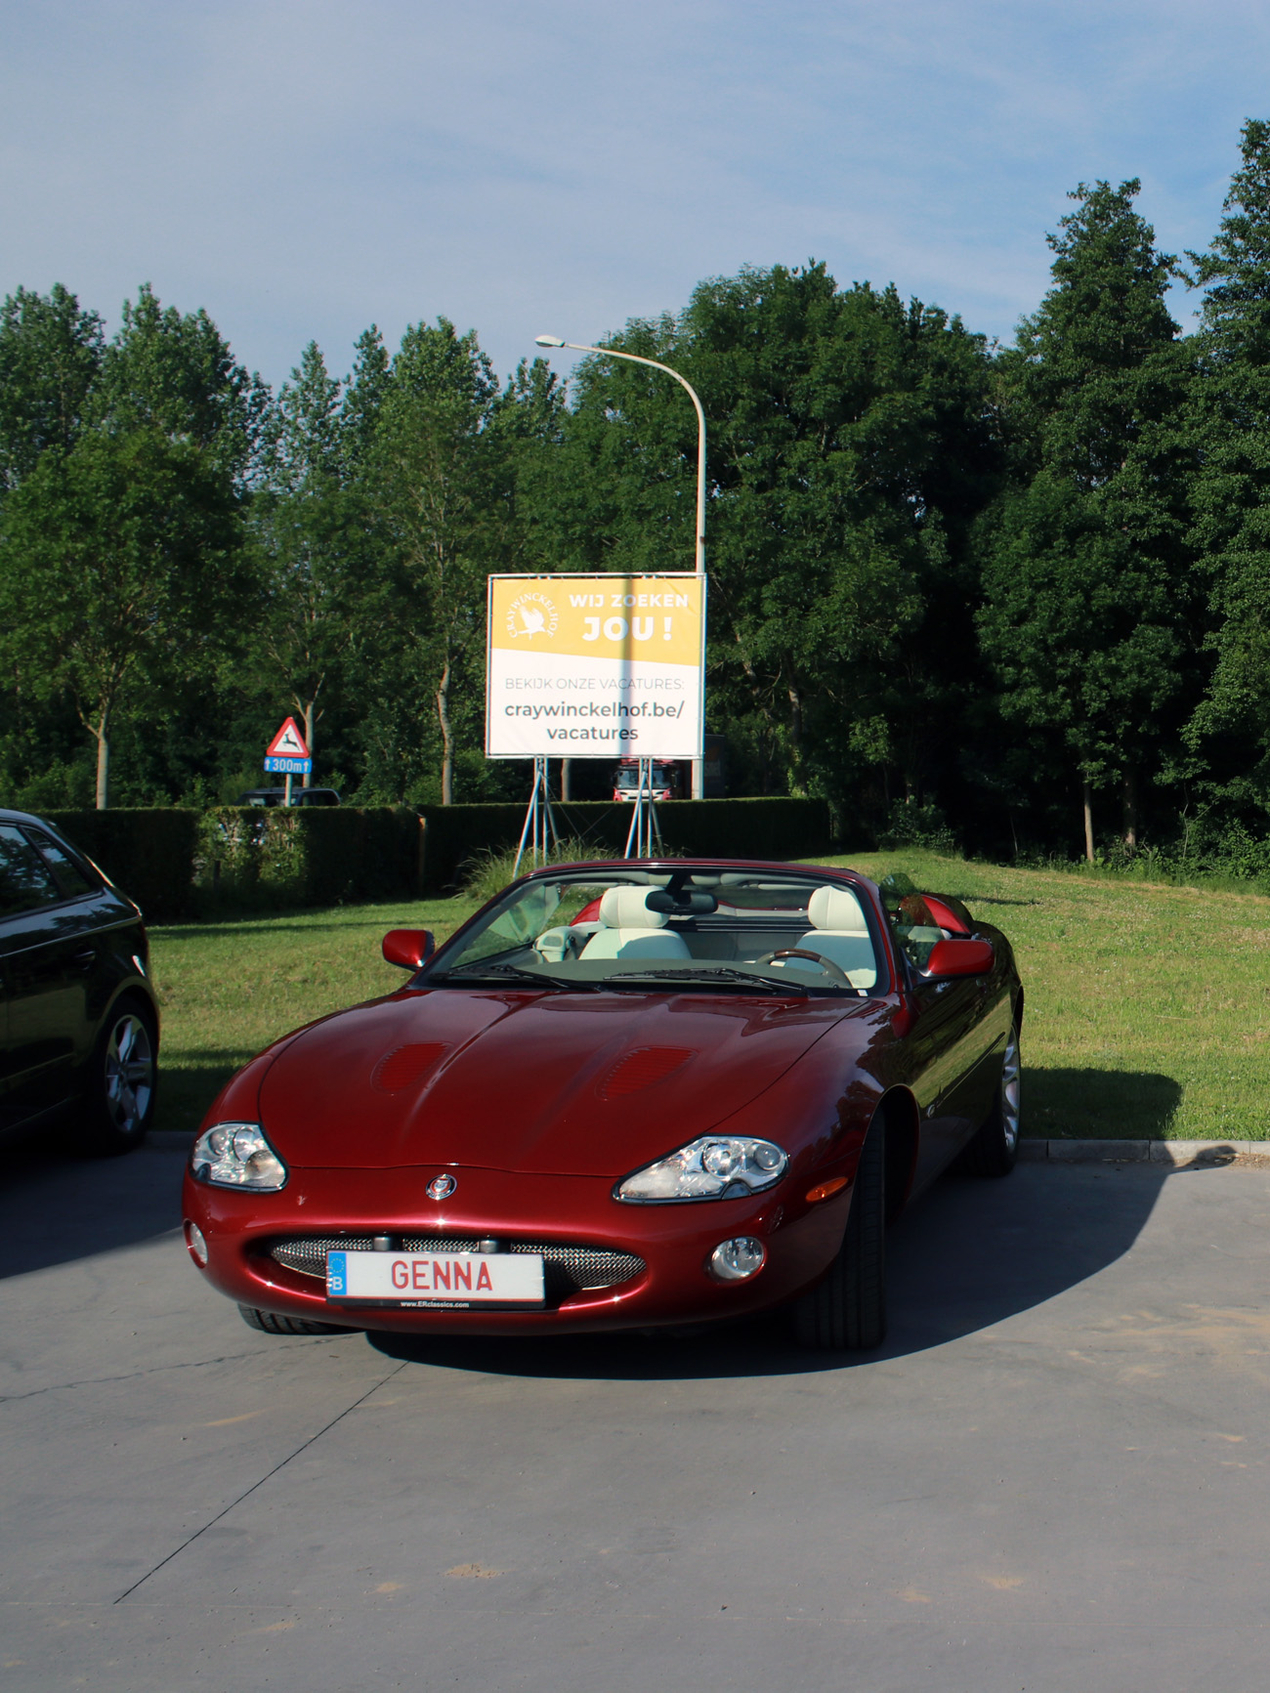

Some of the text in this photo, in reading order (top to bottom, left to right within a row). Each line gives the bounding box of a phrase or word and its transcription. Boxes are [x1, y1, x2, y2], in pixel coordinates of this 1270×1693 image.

[569, 594, 688, 608] WIJ ZOEKEN
[506, 592, 559, 639] CRAYWINCKELHOF
[505, 678, 685, 690] BEKIJK ONZE VACATURES:
[505, 700, 685, 719] craywinckelhof.be/
[547, 726, 639, 740] vacatures
[272, 758, 302, 772] 300m
[391, 1260, 493, 1291] GENNA
[332, 1277, 343, 1290] B
